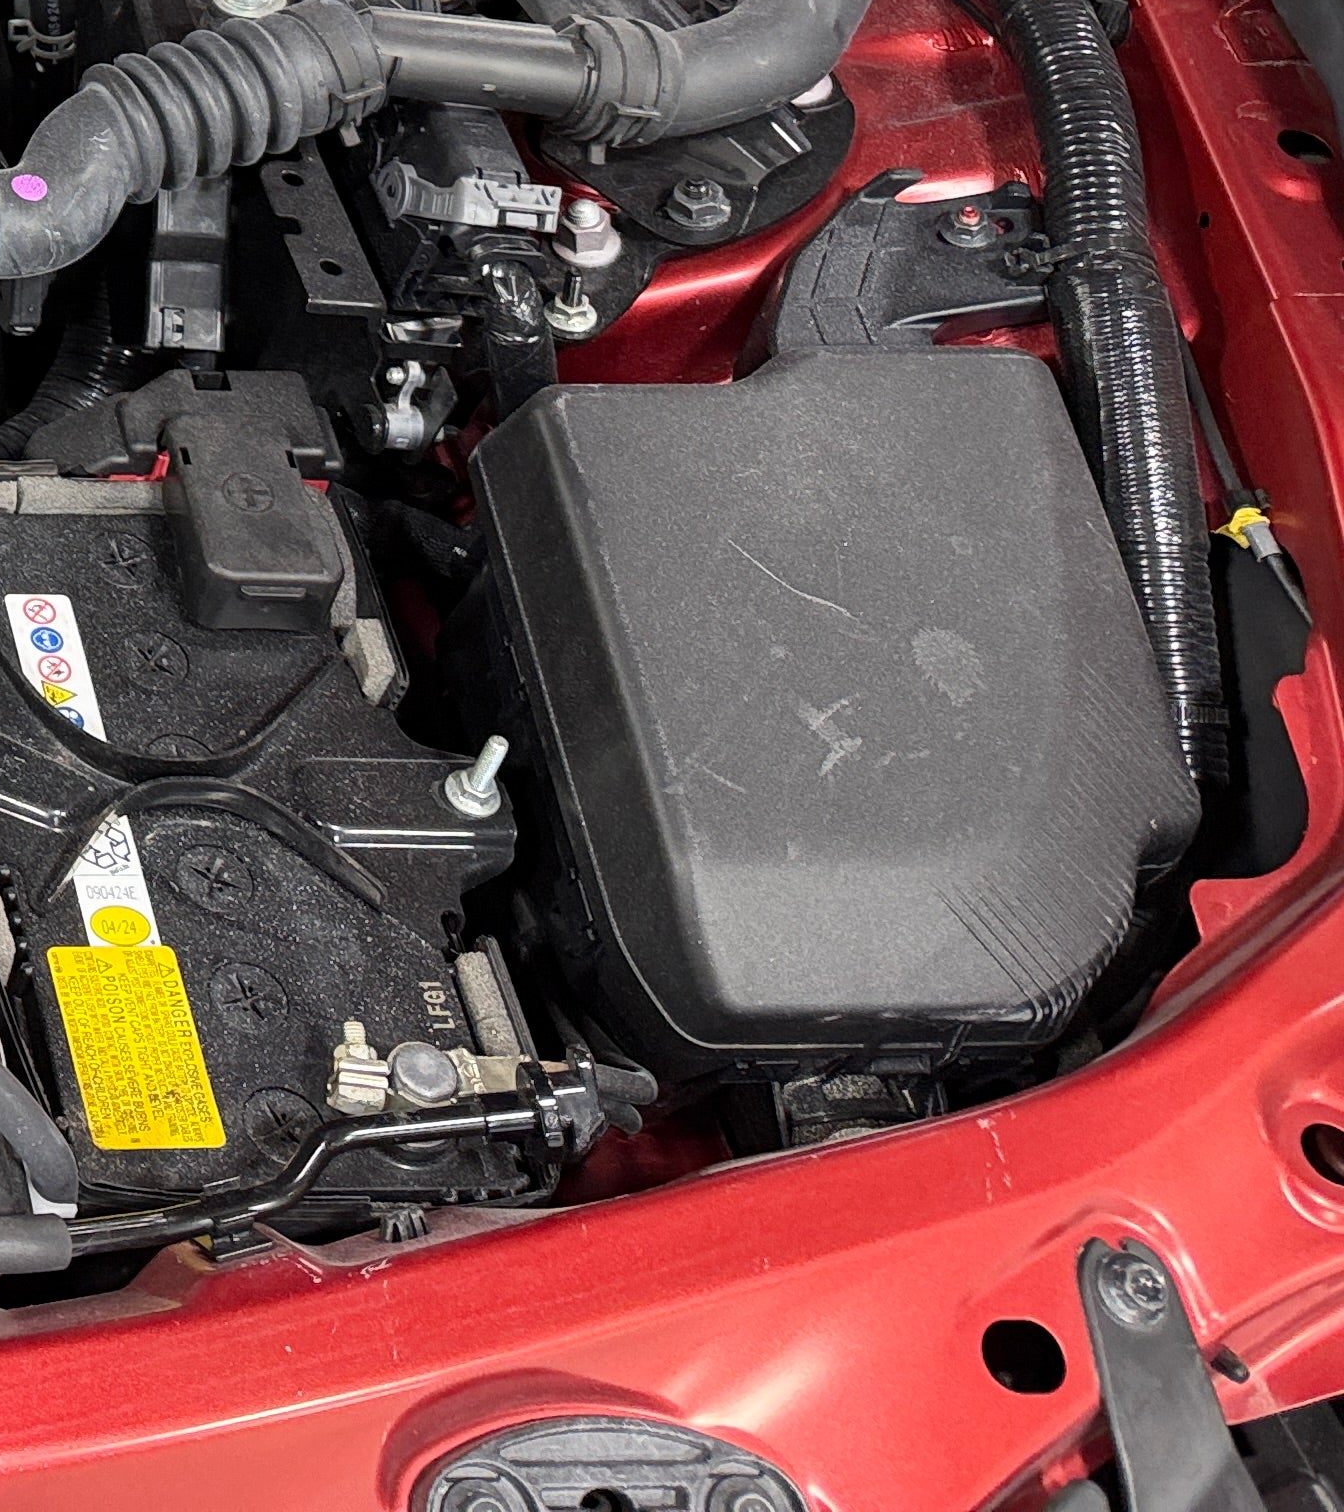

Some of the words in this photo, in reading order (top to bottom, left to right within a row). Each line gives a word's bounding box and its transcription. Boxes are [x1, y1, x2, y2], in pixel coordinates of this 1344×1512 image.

[101, 919, 137, 935] 04/24
[116, 973, 132, 993] KEEP
[72, 998, 87, 1016] OUT
[100, 975, 126, 1023] POISON
[162, 979, 192, 1037] DANGER
